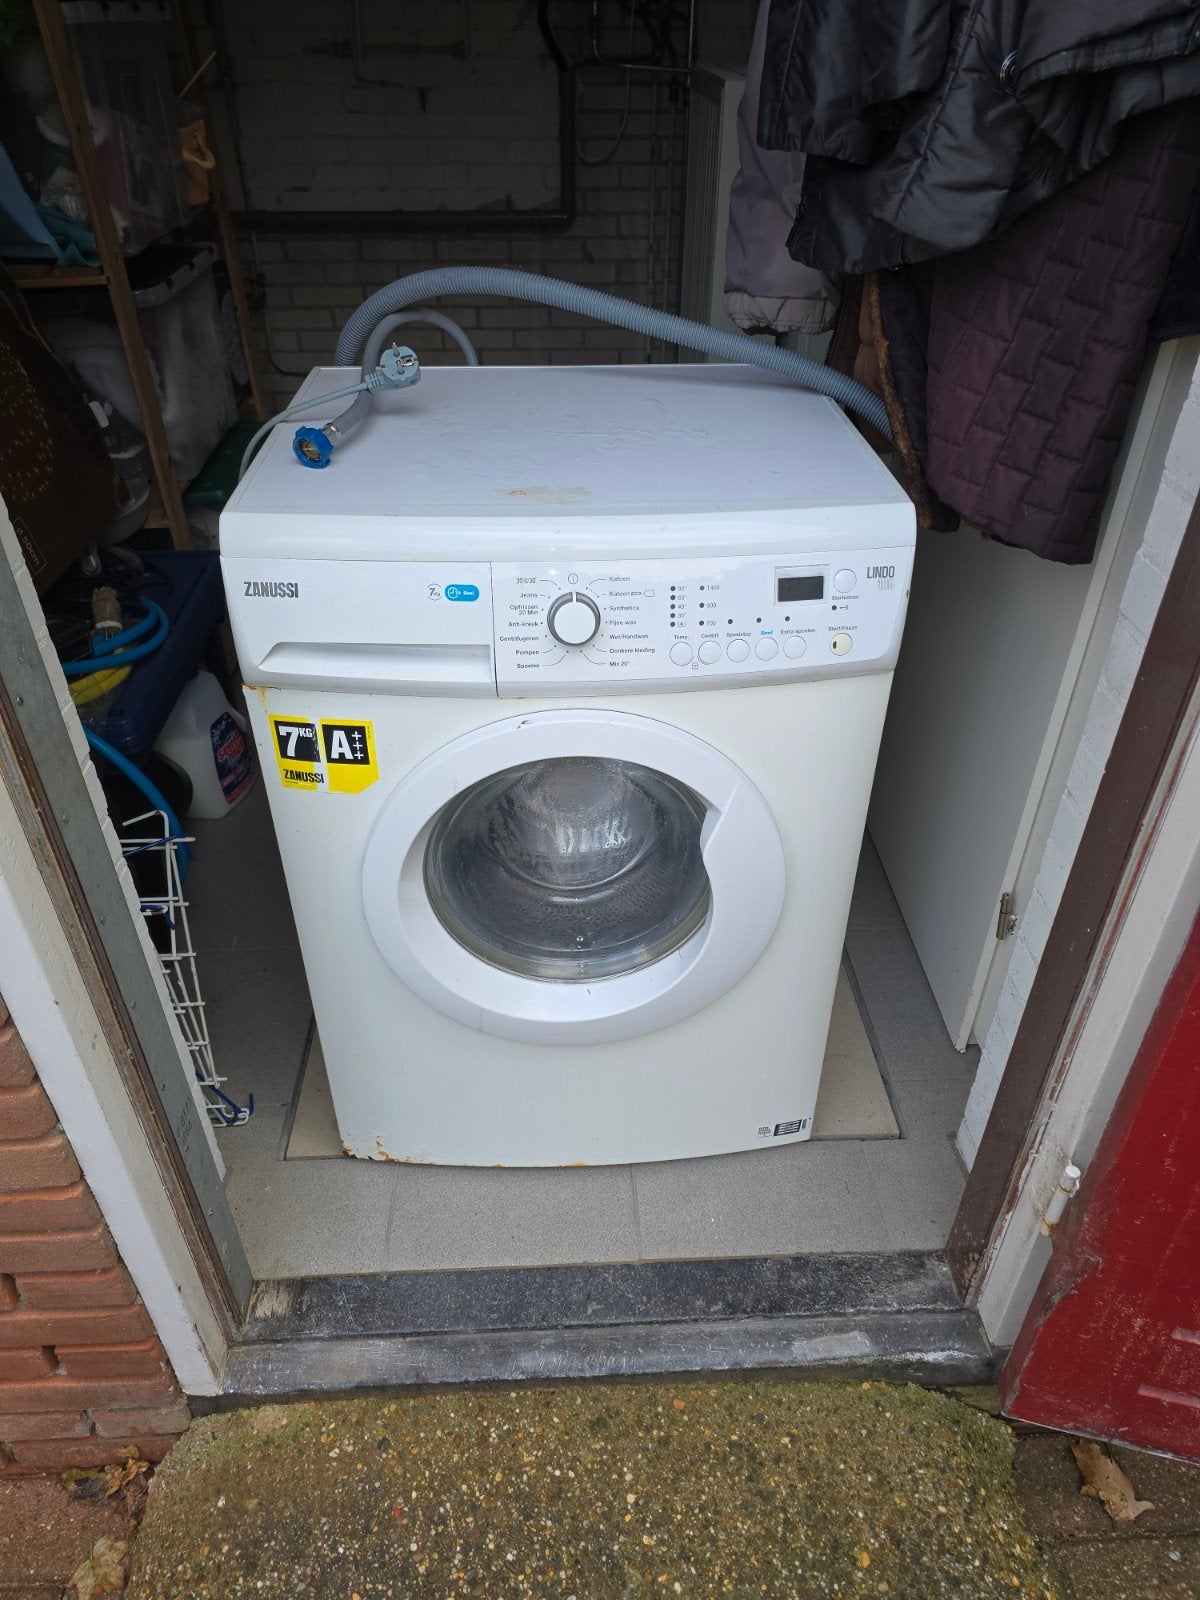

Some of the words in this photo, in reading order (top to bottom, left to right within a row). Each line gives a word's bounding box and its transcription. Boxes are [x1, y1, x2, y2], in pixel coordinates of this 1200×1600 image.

[866, 565, 896, 579] LINDO
[243, 581, 299, 599] ZANUSSI
[878, 579, 894, 590] 100
[282, 769, 325, 784] ZANUSSI
